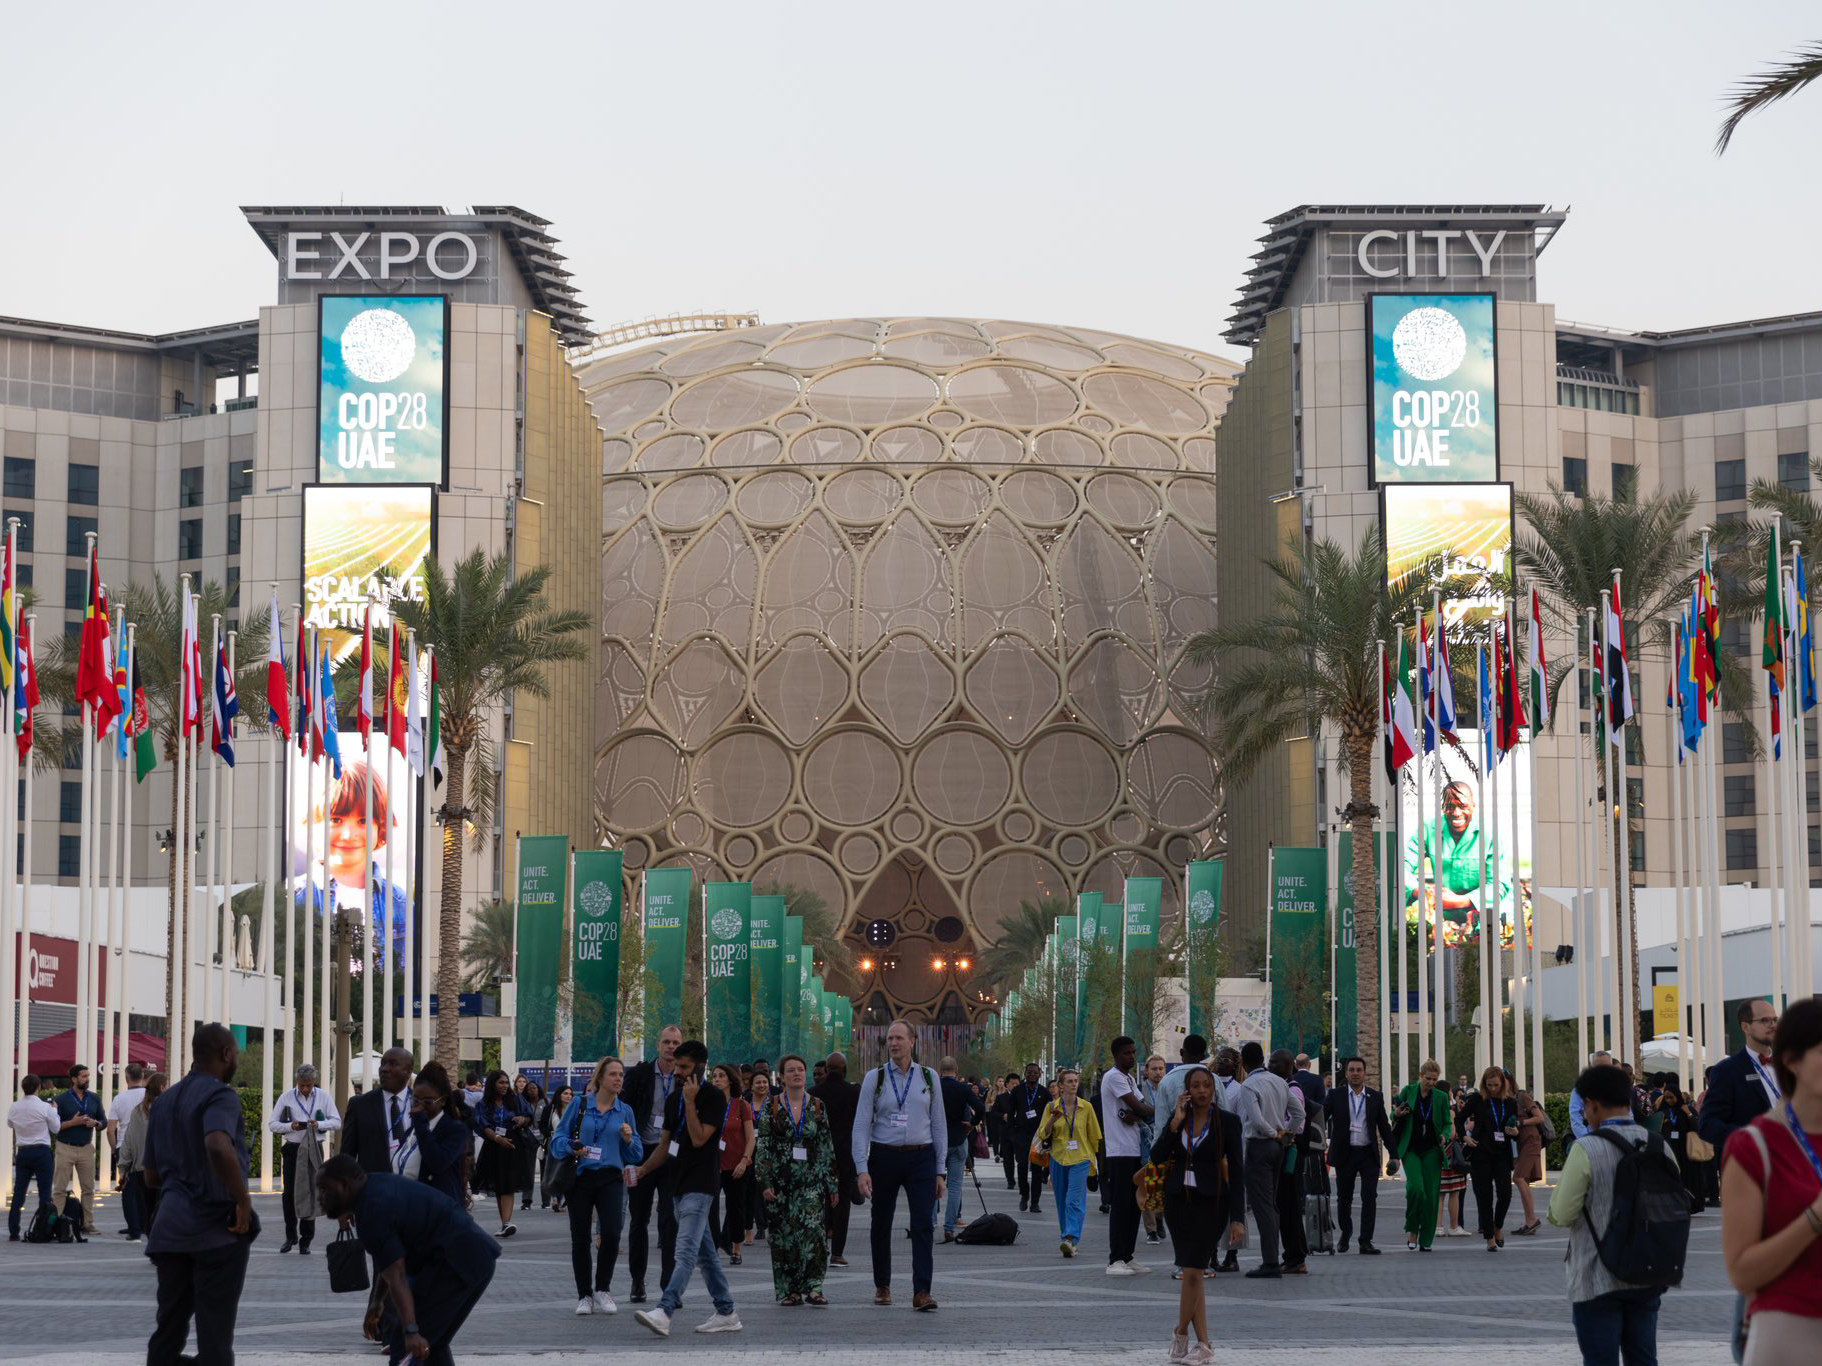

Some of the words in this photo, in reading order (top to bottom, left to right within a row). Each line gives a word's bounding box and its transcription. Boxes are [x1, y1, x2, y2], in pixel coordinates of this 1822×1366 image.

[287, 231, 478, 281] EXPO
[1357, 229, 1508, 279] CITY
[338, 391, 427, 431] COP28
[1392, 389, 1480, 428] COP28
[338, 431, 396, 469] UAE
[1392, 429, 1450, 467] UAE
[523, 866, 549, 877] UNITE.
[522, 879, 539, 890] ACT.
[1278, 876, 1307, 887] UNITE.
[522, 892, 557, 904] DELIVER.
[1277, 889, 1297, 899] ACT.
[649, 895, 674, 905] UNITE.
[648, 907, 665, 916] ACT.
[1128, 903, 1147, 913] UNITE.
[1277, 901, 1318, 912] DELIVER.
[648, 917, 681, 927] DELIVER.
[1127, 914, 1139, 923] ACT.
[578, 921, 618, 941] COP28
[1128, 925, 1151, 933] DELIVER.
[578, 941, 603, 960] UAE
[711, 943, 748, 961] COP28
[711, 961, 735, 977] UAE
